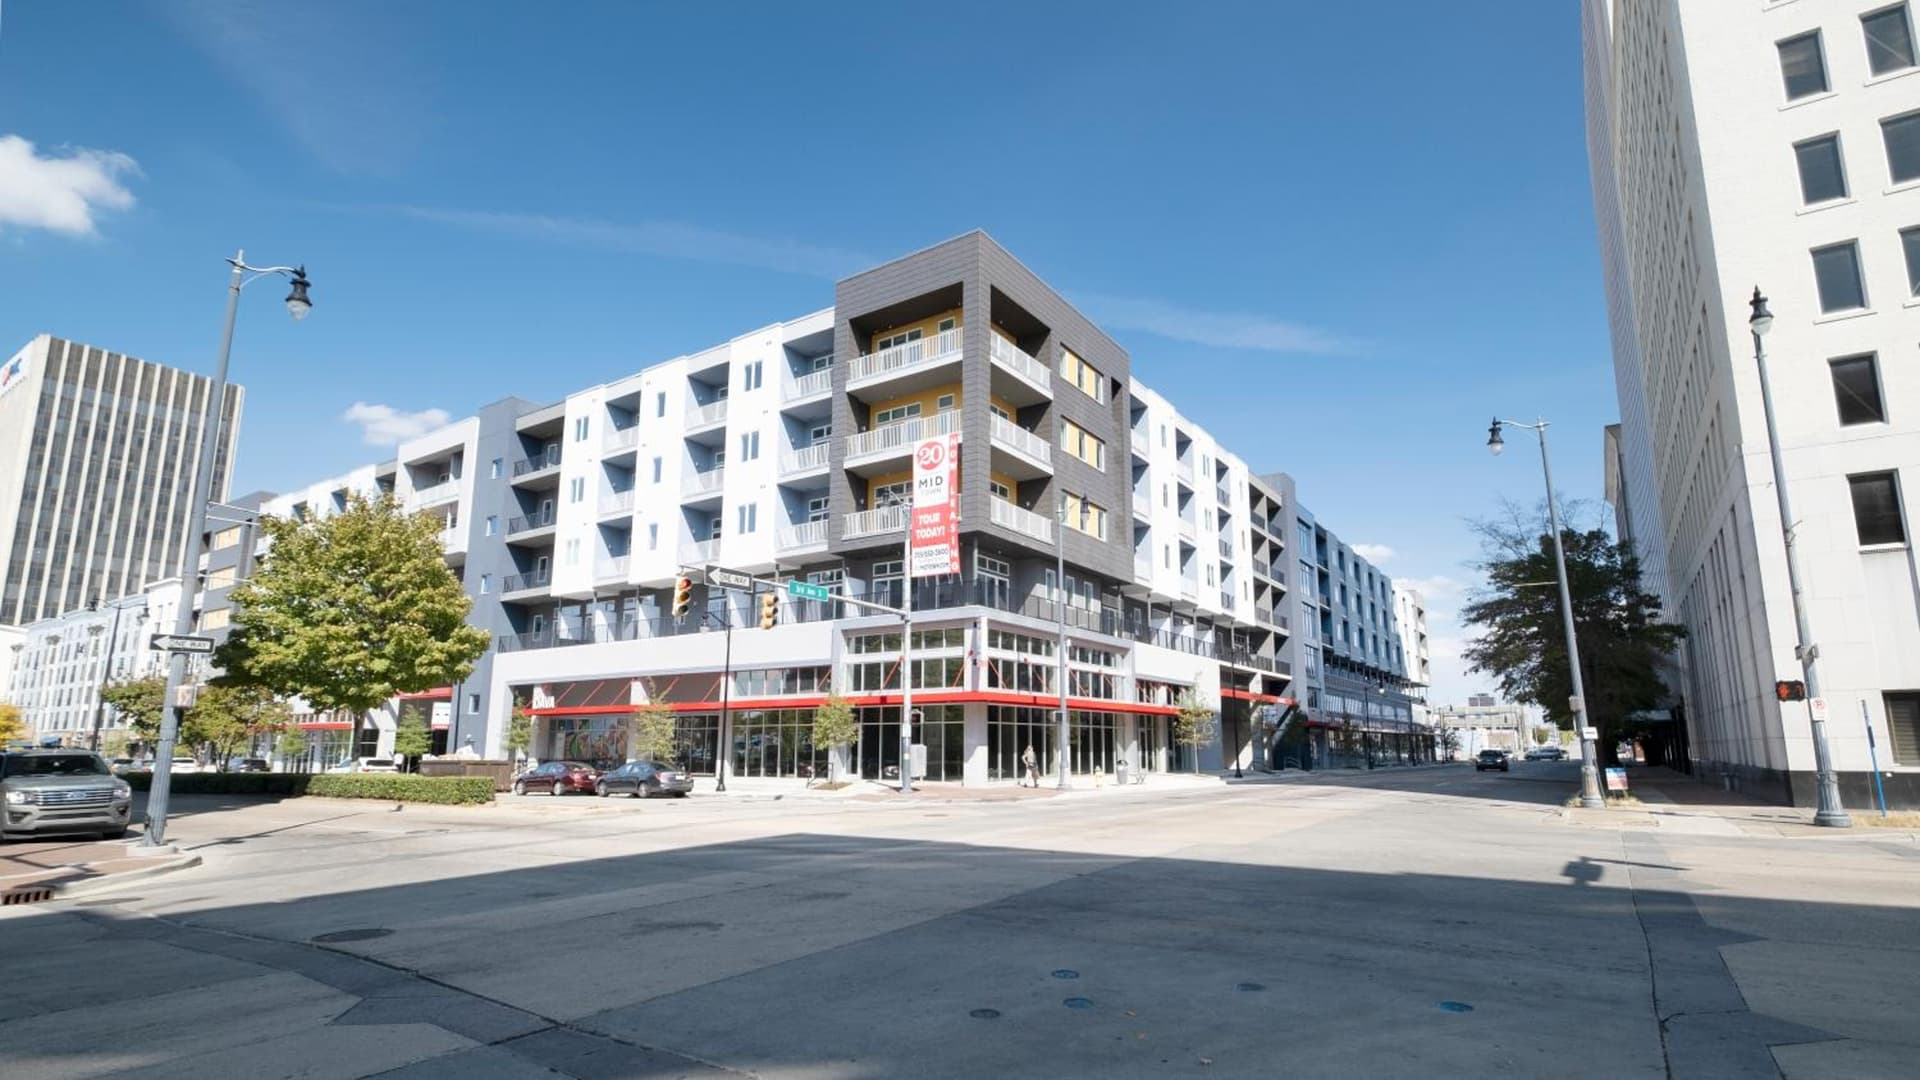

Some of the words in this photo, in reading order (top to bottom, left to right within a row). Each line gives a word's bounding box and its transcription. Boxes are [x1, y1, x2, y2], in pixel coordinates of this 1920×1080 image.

[918, 445, 943, 465] 20
[919, 476, 943, 489] MID
[919, 513, 940, 525] TOUR
[917, 525, 944, 539] TODAY!
[950, 486, 958, 570] LEASING
[735, 575, 748, 585] WAY
